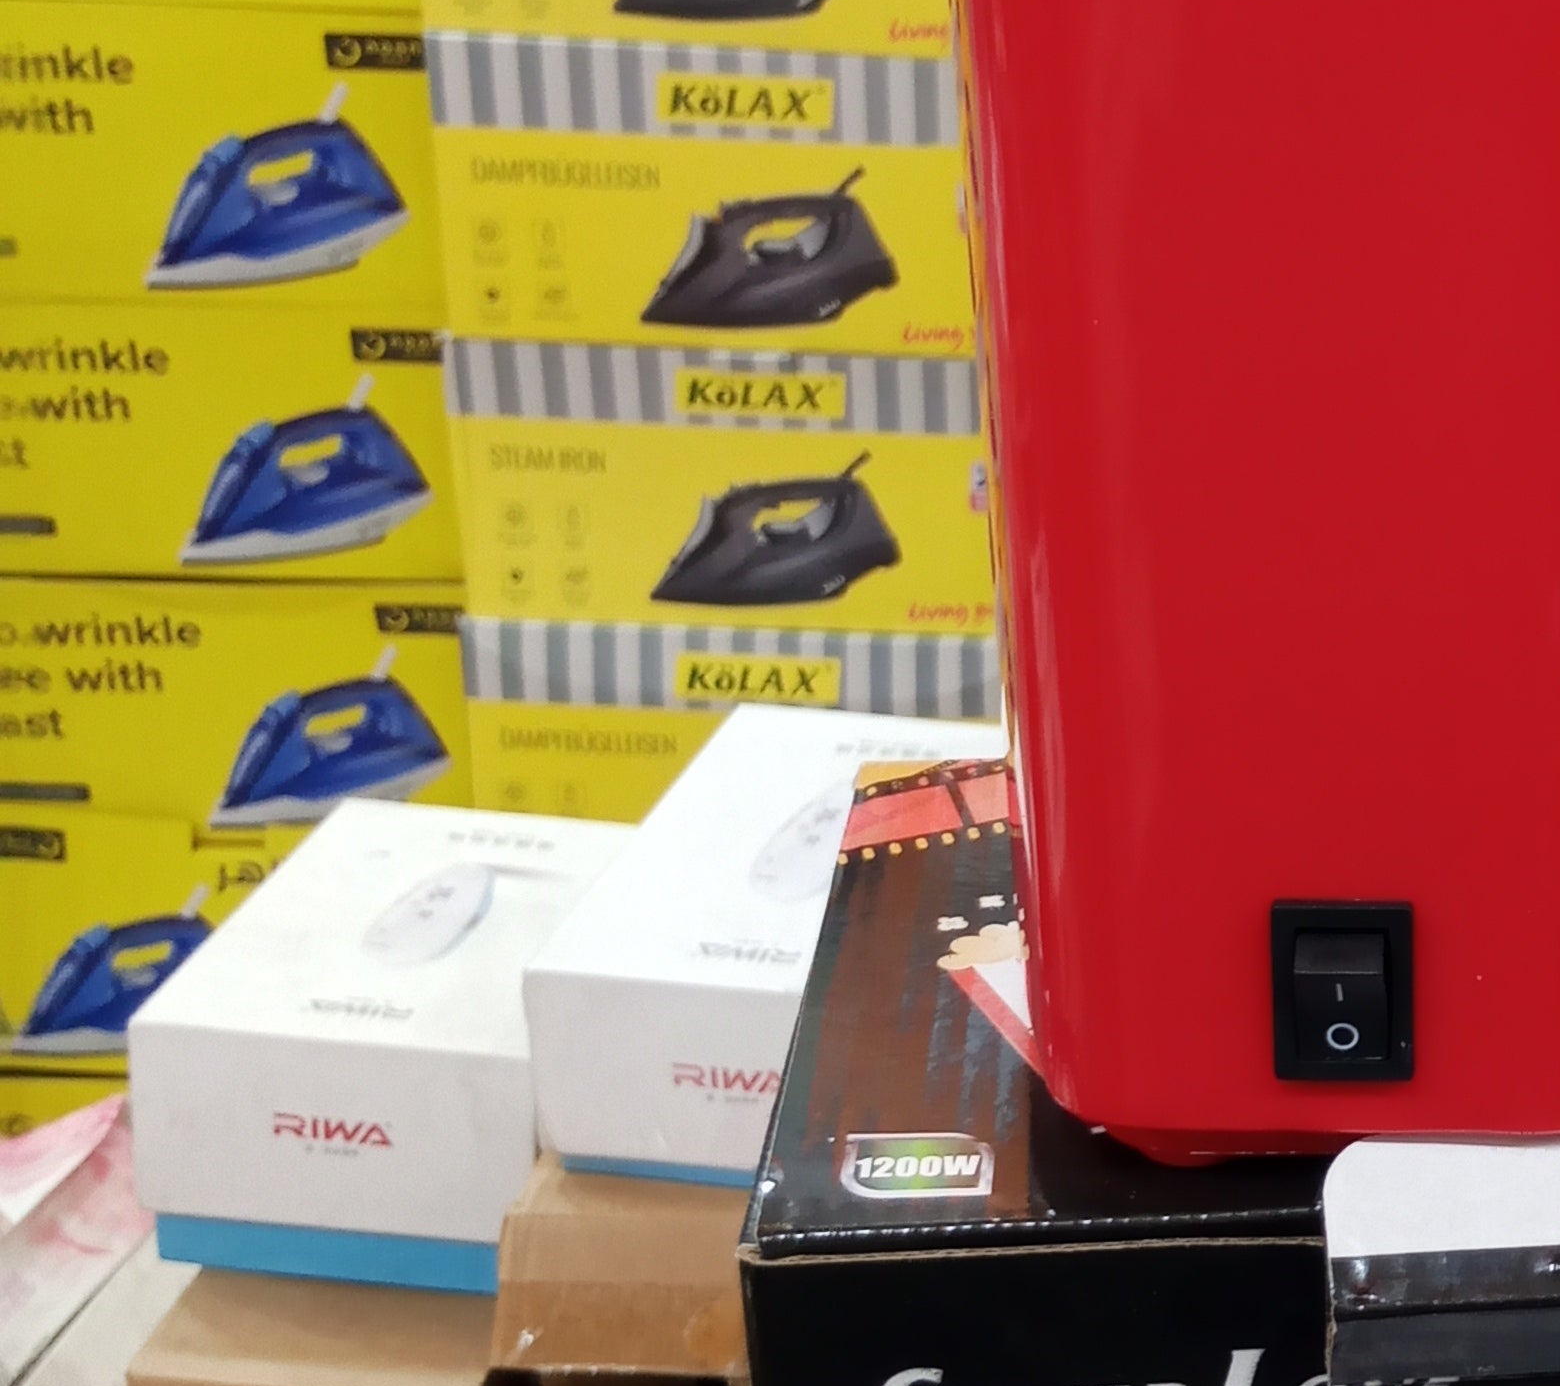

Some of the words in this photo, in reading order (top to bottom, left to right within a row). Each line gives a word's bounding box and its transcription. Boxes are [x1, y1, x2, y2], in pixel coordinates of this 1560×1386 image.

[0, 42, 134, 85] rinkle
[33, 613, 200, 648] wrinkle
[66, 658, 163, 693] with
[273, 1112, 393, 1147] RIWA
[855, 1154, 981, 1179] 1200W
